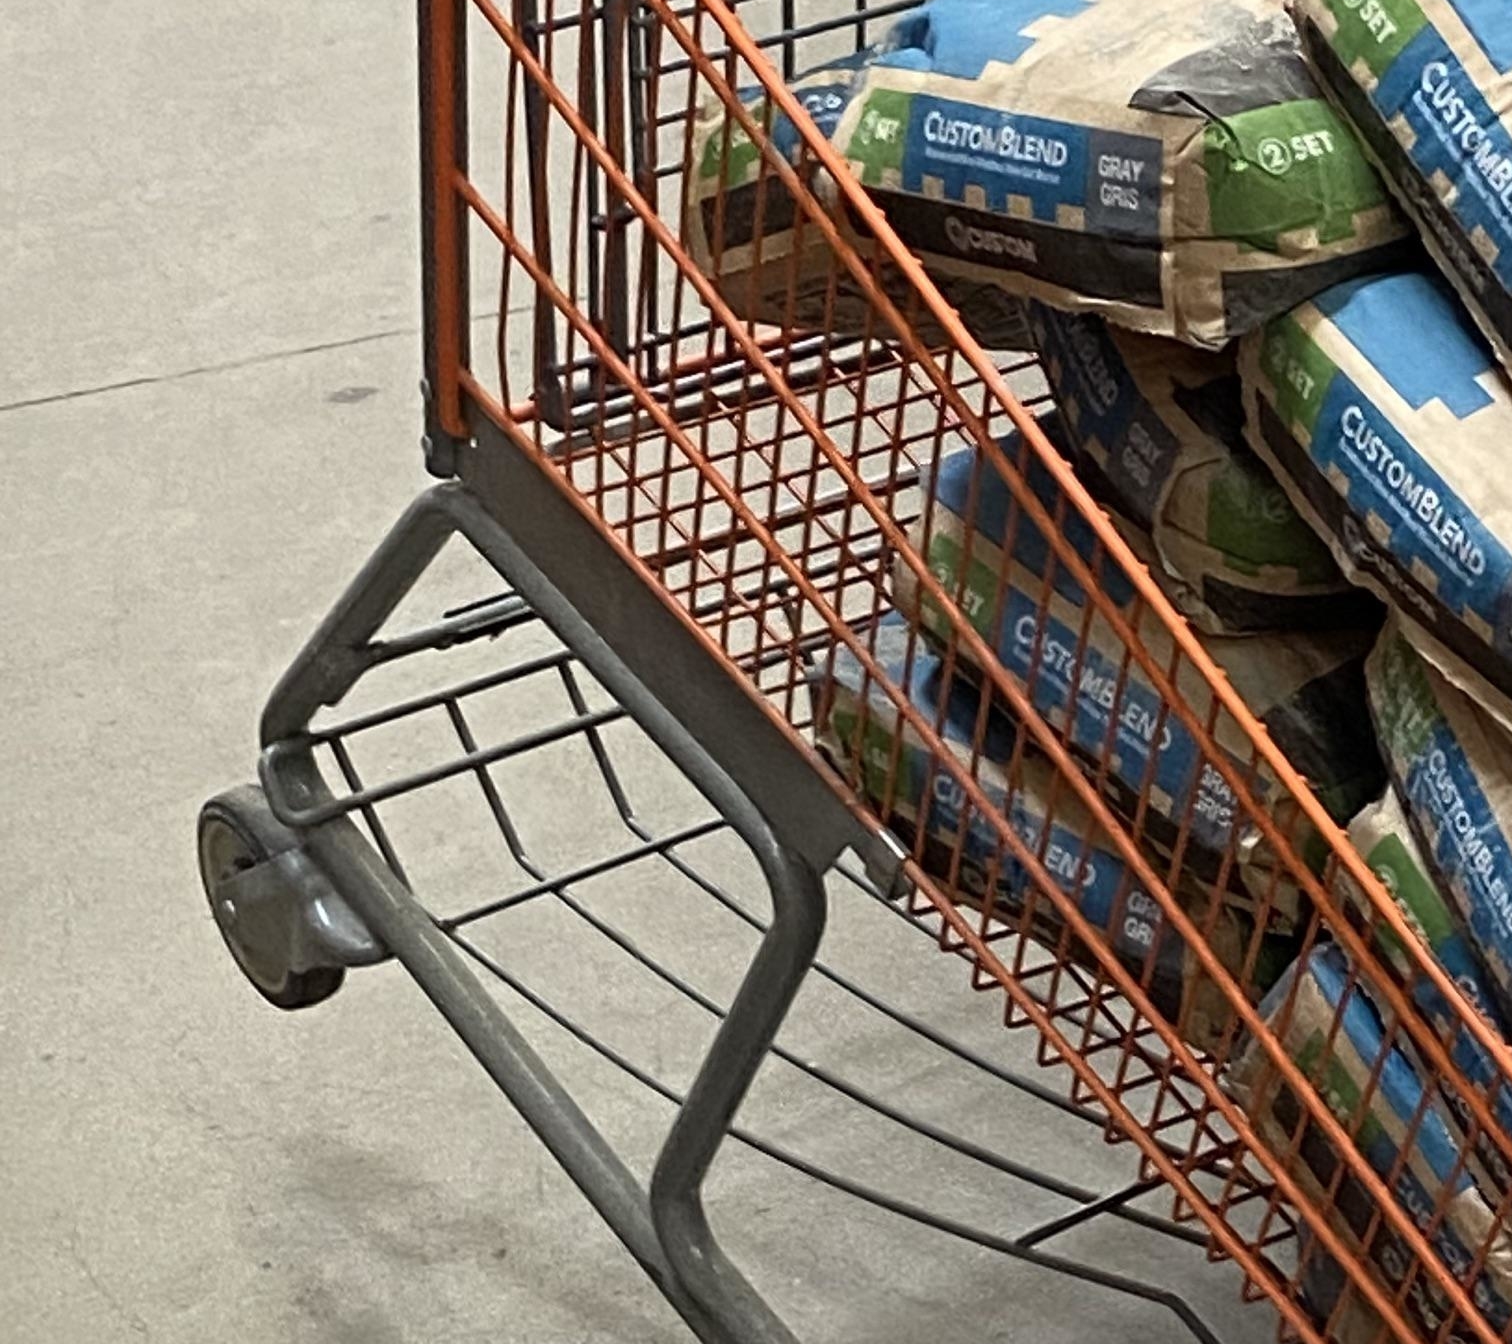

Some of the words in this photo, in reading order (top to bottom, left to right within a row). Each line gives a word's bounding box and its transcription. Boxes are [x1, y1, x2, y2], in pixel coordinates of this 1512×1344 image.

[923, 110, 1068, 168] CUSTOMBLEND
[1290, 130, 1335, 162] SET
[1097, 154, 1146, 183] GRAY
[1099, 182, 1140, 211] GRIS
[1341, 405, 1486, 577] CUSTOMBLEND
[1013, 614, 1172, 751] CSTMBEND
